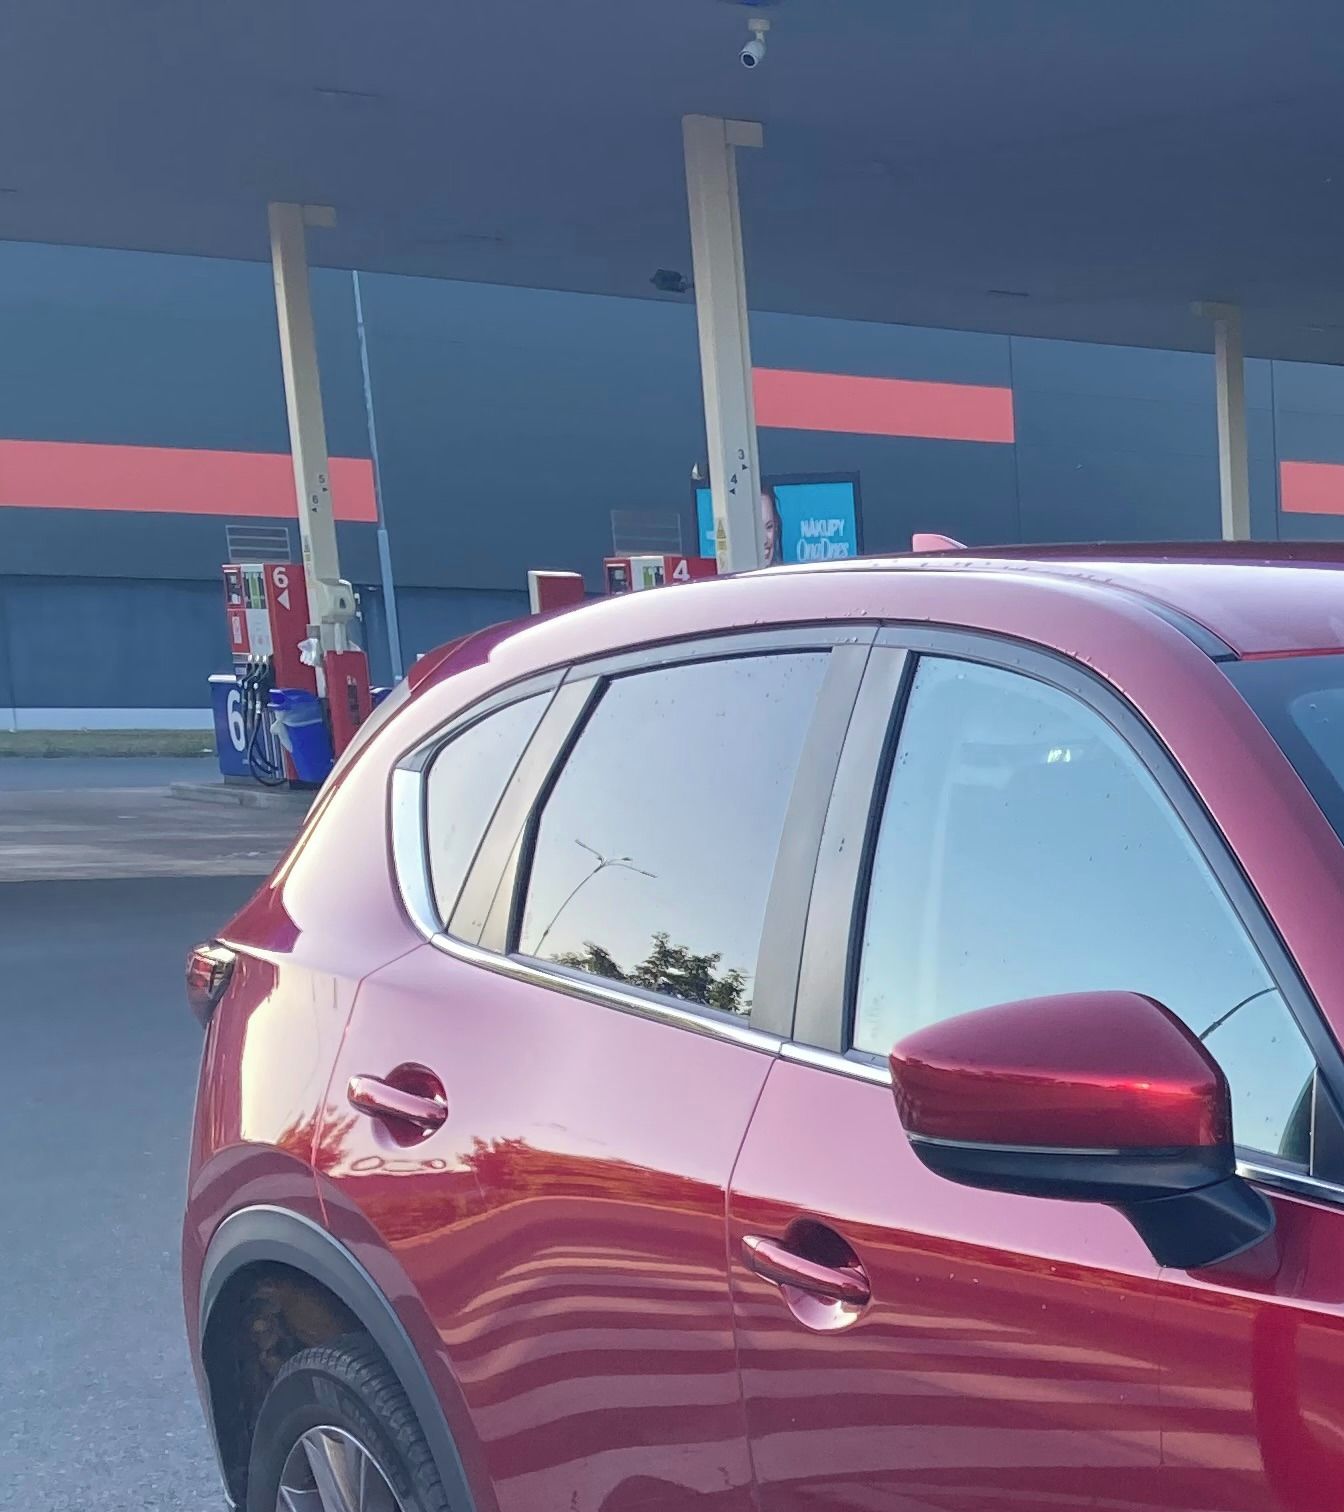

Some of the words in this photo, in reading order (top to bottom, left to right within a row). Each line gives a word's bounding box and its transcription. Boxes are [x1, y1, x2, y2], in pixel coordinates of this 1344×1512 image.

[738, 448, 745, 460] 3
[318, 474, 326, 484] 5
[730, 473, 738, 485] 4
[312, 495, 319, 505] 6
[673, 559, 691, 581] 4
[272, 566, 289, 589] 6
[227, 689, 246, 752] 6
